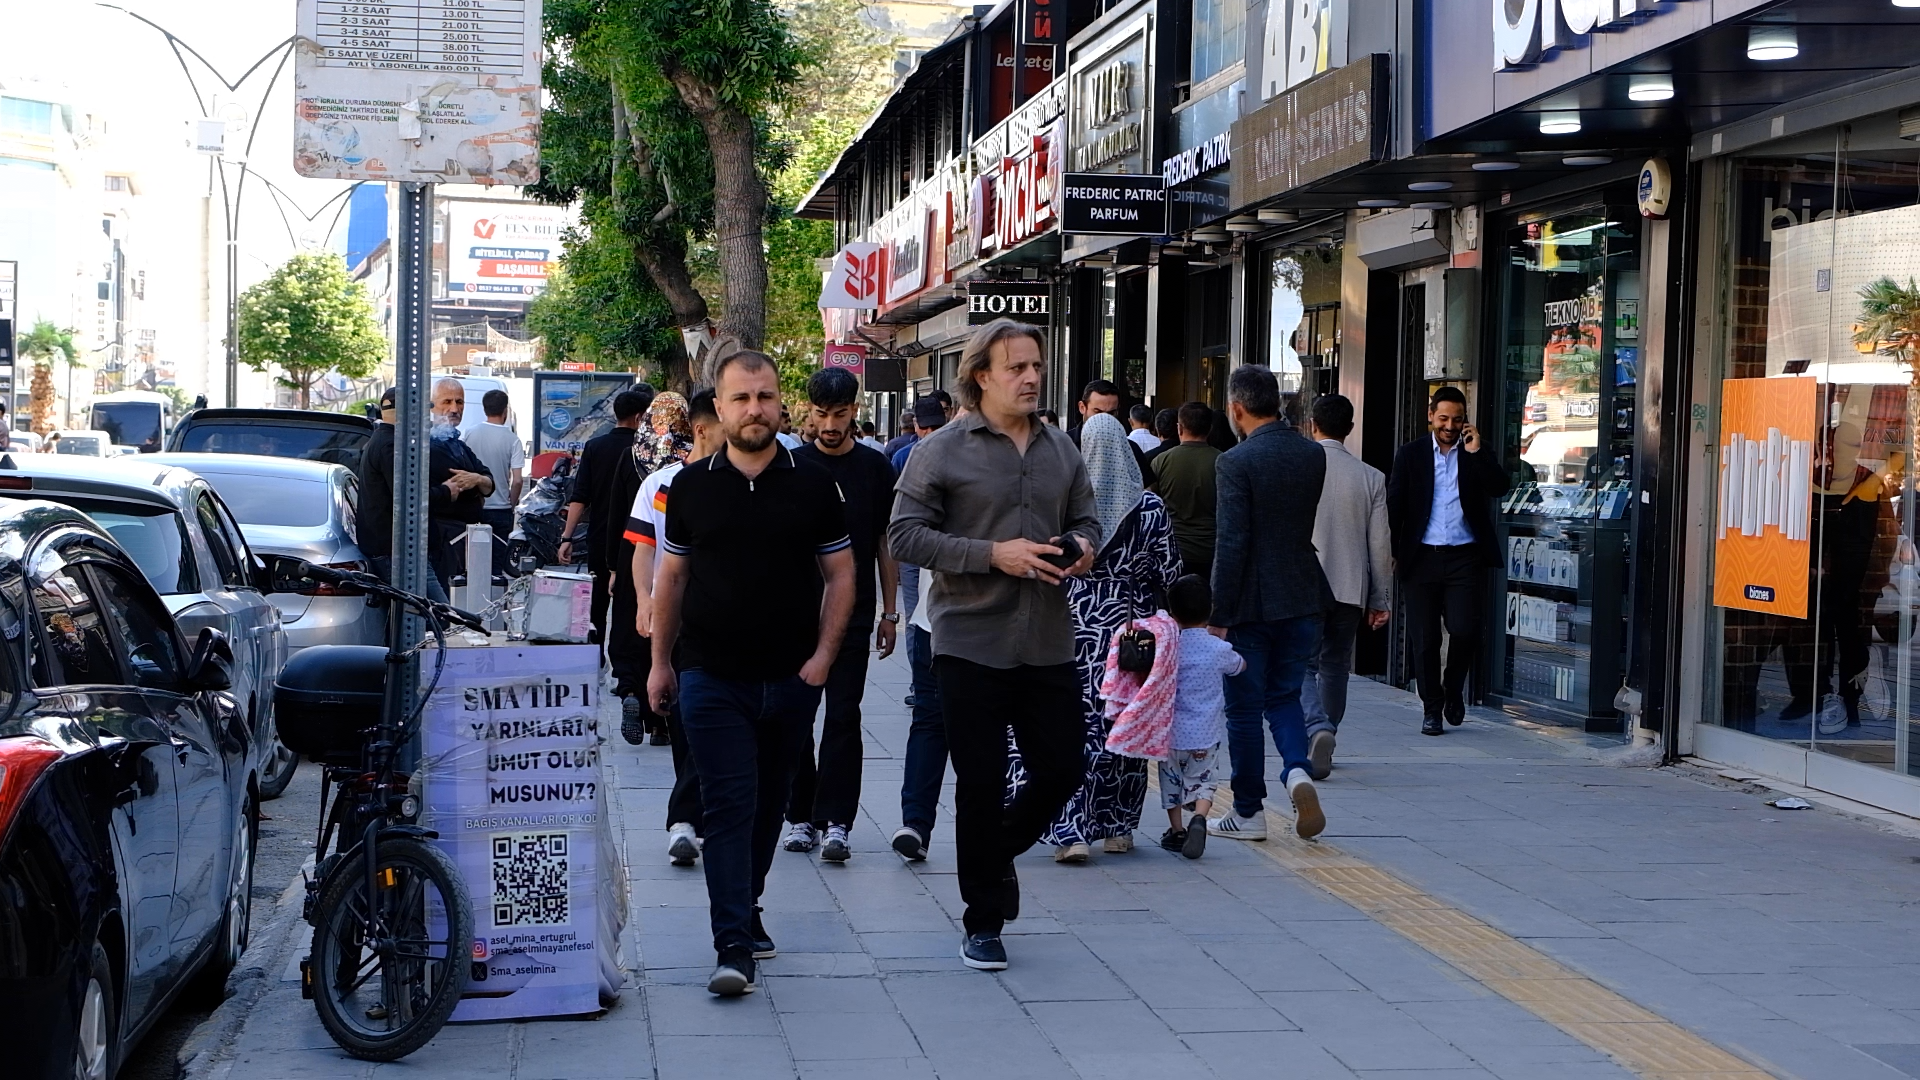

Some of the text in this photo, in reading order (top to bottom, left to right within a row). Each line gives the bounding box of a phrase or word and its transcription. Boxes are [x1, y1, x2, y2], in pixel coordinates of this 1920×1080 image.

[362, 7, 391, 15] SAAT
[362, 18, 391, 26] SAAT
[362, 29, 391, 37] SAAT
[362, 40, 391, 48] SAAT
[337, 50, 363, 58] SAAT
[381, 51, 413, 60] ÜZERİ
[379, 62, 430, 70] ABONELİK
[1163, 146, 1199, 189] FREDERIC
[1065, 187, 1165, 202] FREDERIC PATRIC
[1090, 207, 1139, 221] PARFUM
[831, 352, 860, 366] eve
[545, 441, 566, 450] VAN
[464, 677, 591, 712] SMA TİP-1
[487, 751, 542, 772] UMUT
[490, 782, 596, 804] MUSUNUZ?
[466, 816, 498, 830] BAĞIŞ
[500, 815, 558, 827] KANALLARI
[490, 931, 577, 946] asel_mina_ertugrul
[490, 965, 557, 977] Sma_aselmina
